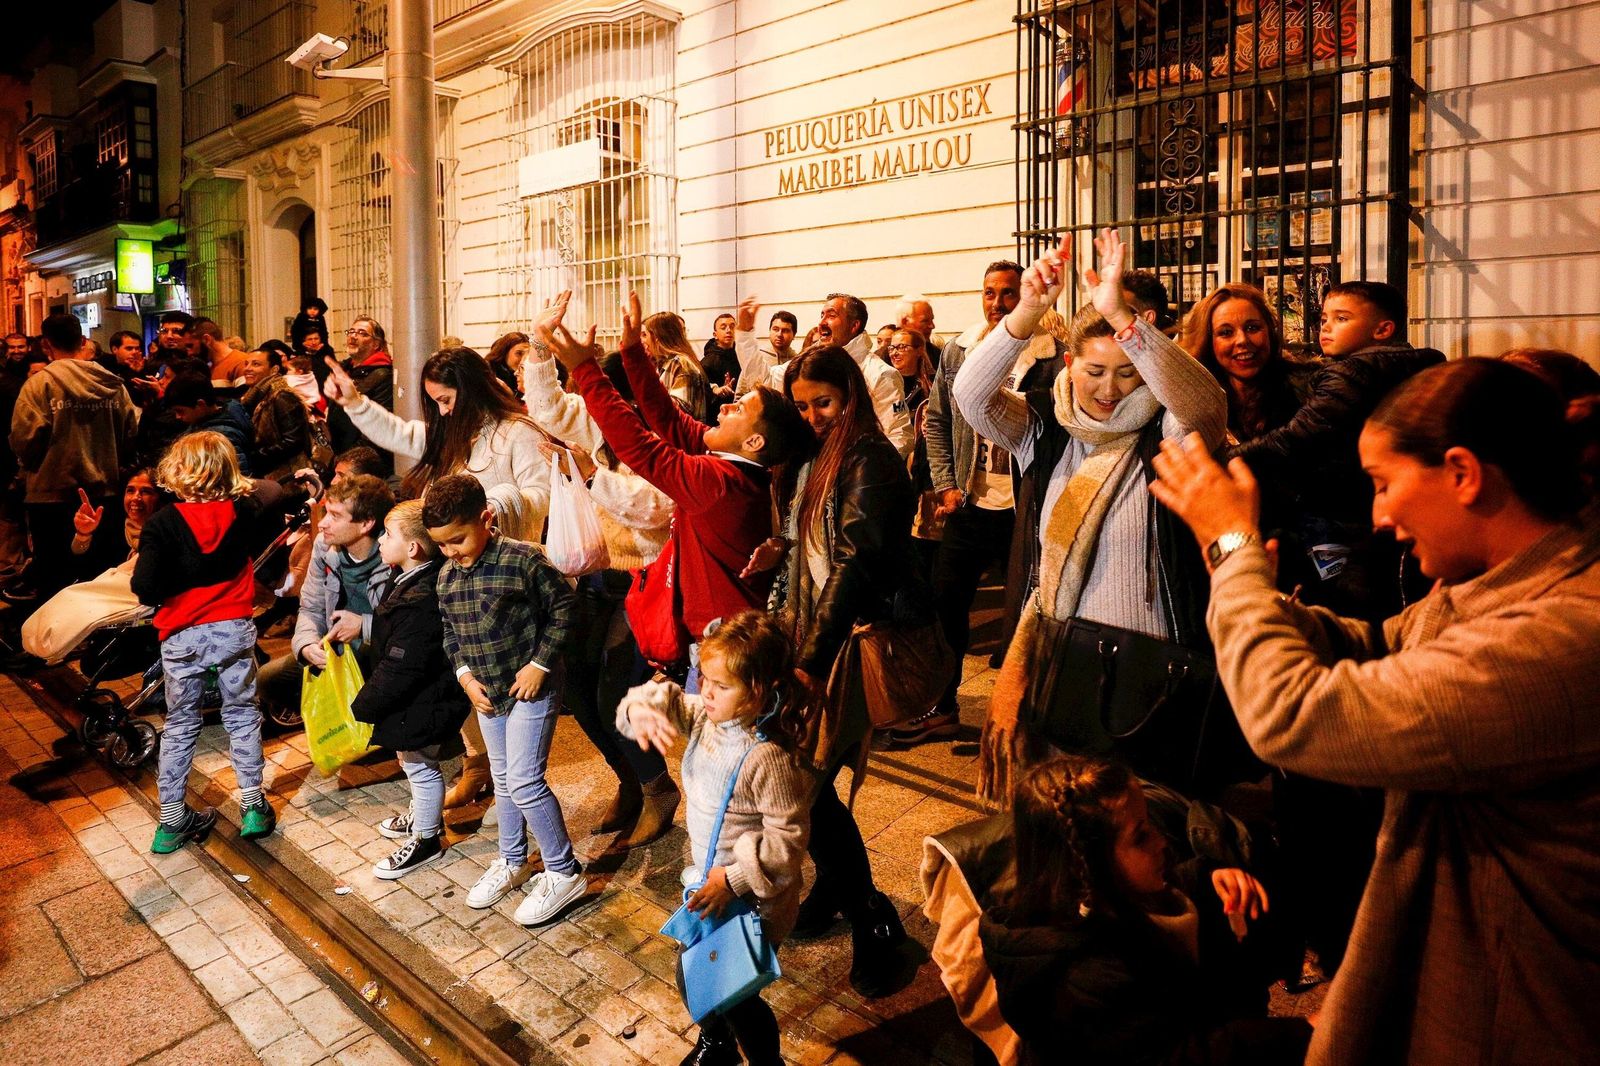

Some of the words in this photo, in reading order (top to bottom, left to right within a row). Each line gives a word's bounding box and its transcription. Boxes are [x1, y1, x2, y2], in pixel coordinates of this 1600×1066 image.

[764, 97, 893, 158] PELUQUERÍA
[898, 83, 993, 130] UNISEX
[778, 154, 867, 195] MARIBEL
[871, 133, 973, 180] MALLOU
